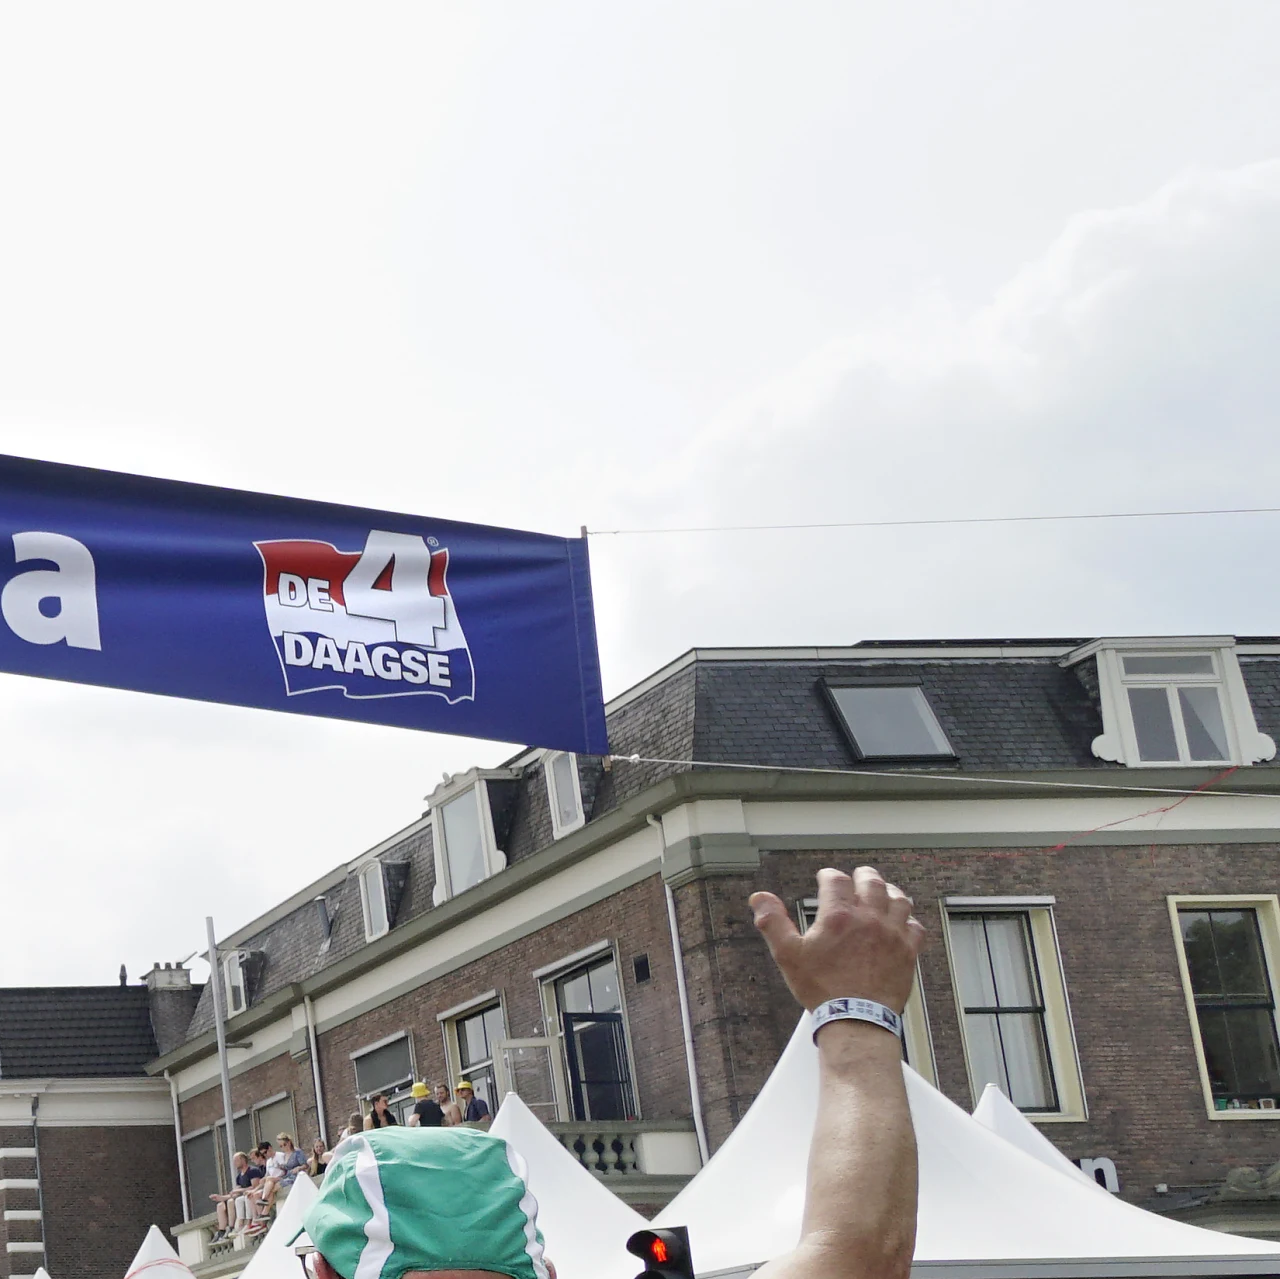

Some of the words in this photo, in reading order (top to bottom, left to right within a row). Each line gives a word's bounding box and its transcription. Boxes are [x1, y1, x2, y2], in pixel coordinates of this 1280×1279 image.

[278, 572, 334, 612] DE
[342, 529, 447, 649] 4
[282, 631, 452, 688] DAAGSE
